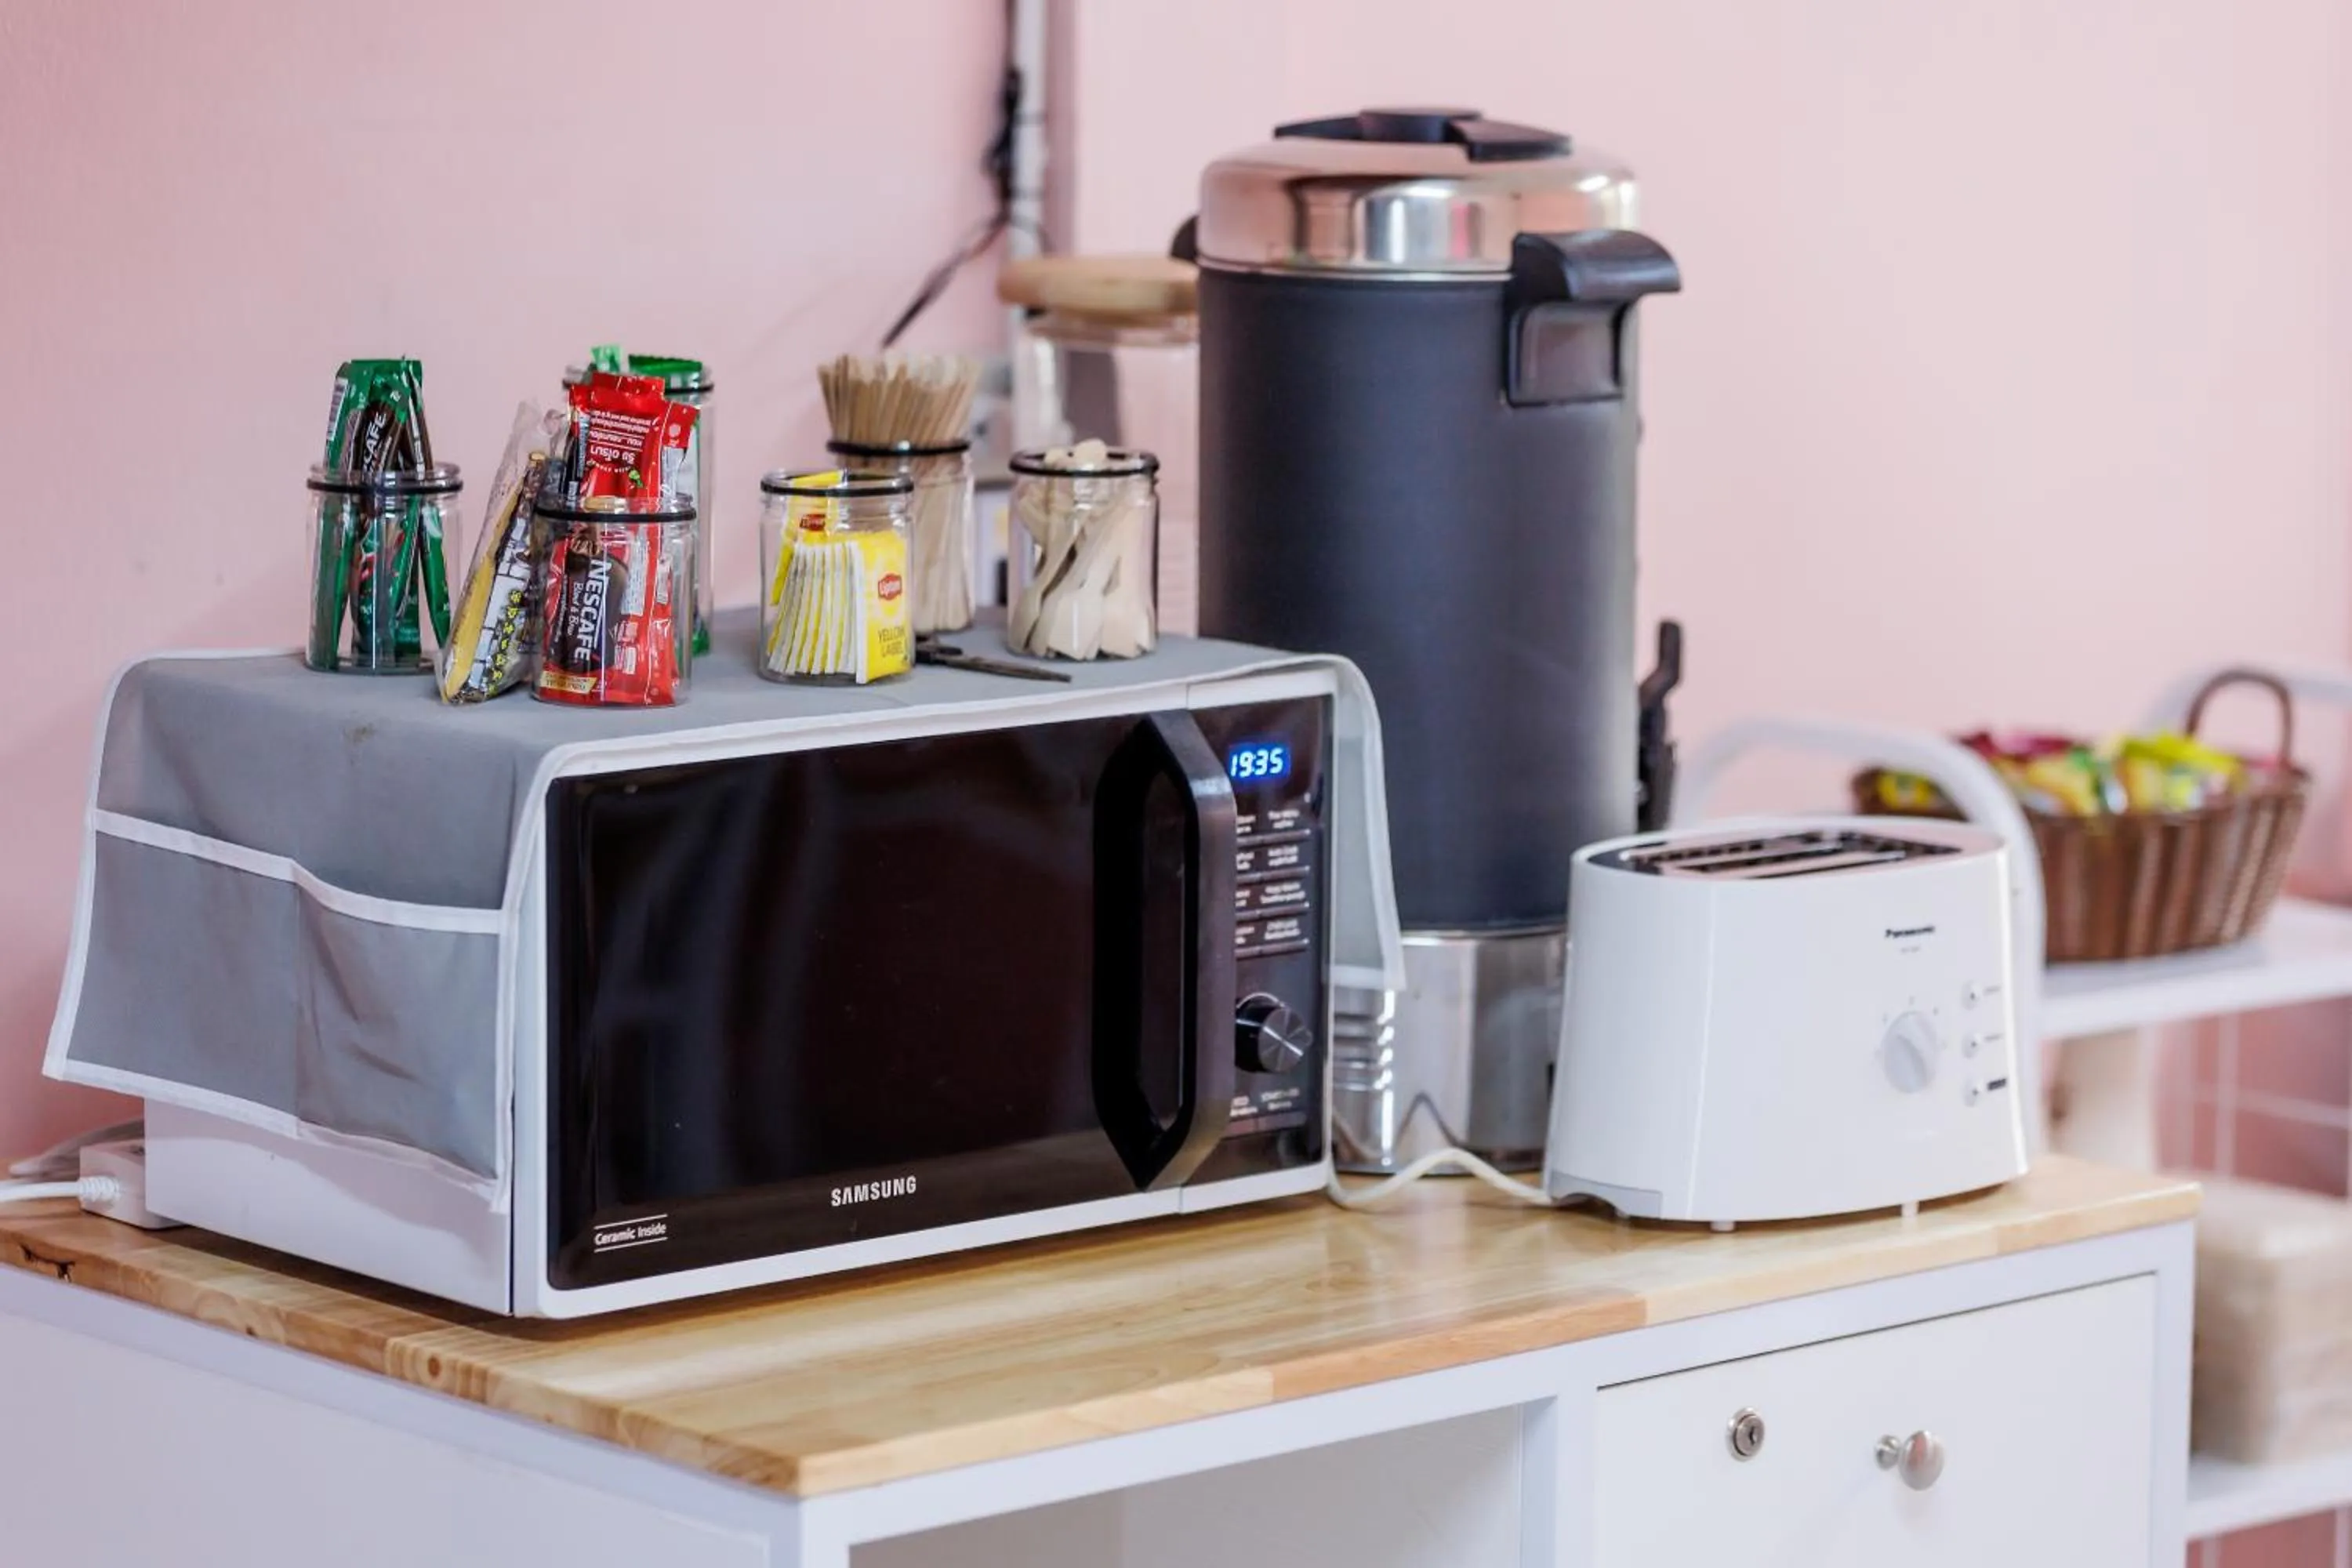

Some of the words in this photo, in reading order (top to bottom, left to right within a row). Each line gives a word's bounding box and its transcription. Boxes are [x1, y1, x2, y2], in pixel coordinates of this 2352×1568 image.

[831, 1175, 916, 1207] SAMSUNG
[595, 1227, 636, 1246] Ceramic
[637, 1222, 667, 1238] Inside
